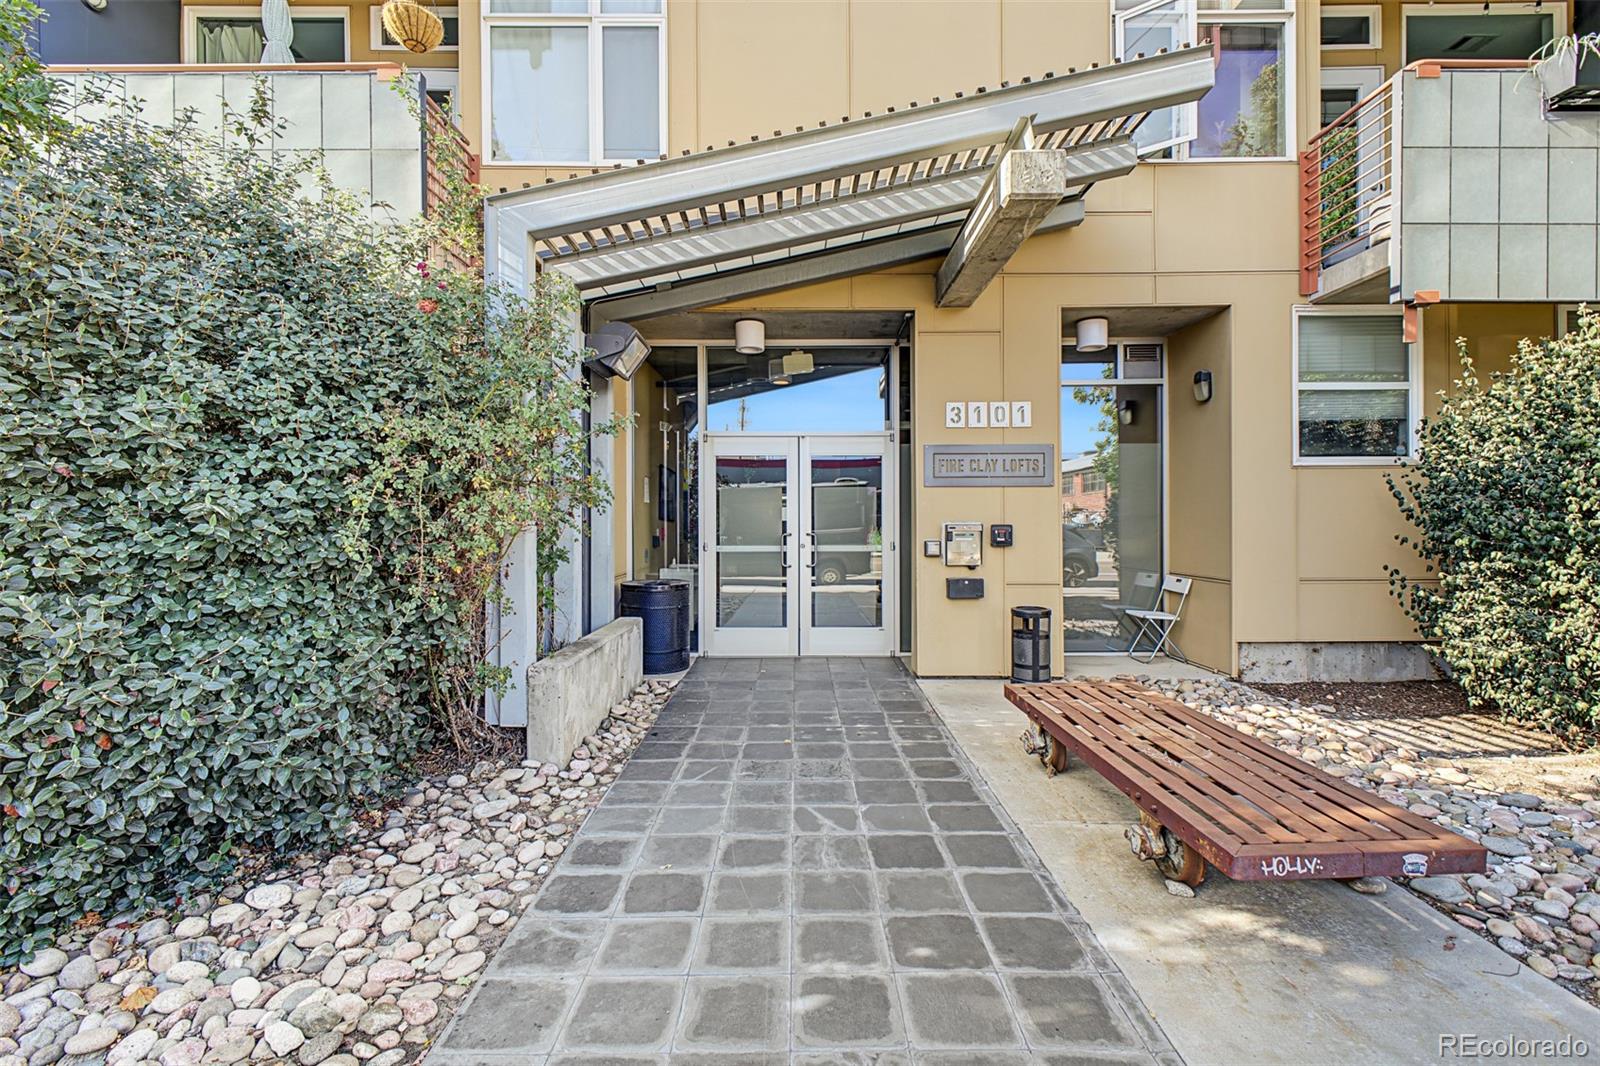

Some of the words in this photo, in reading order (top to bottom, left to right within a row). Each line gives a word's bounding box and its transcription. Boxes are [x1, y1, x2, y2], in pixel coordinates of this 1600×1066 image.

[950, 405, 1025, 424] 3101
[938, 458, 965, 473] FIRE
[969, 458, 998, 473] CLAY
[1002, 458, 1040, 473] LOFTS
